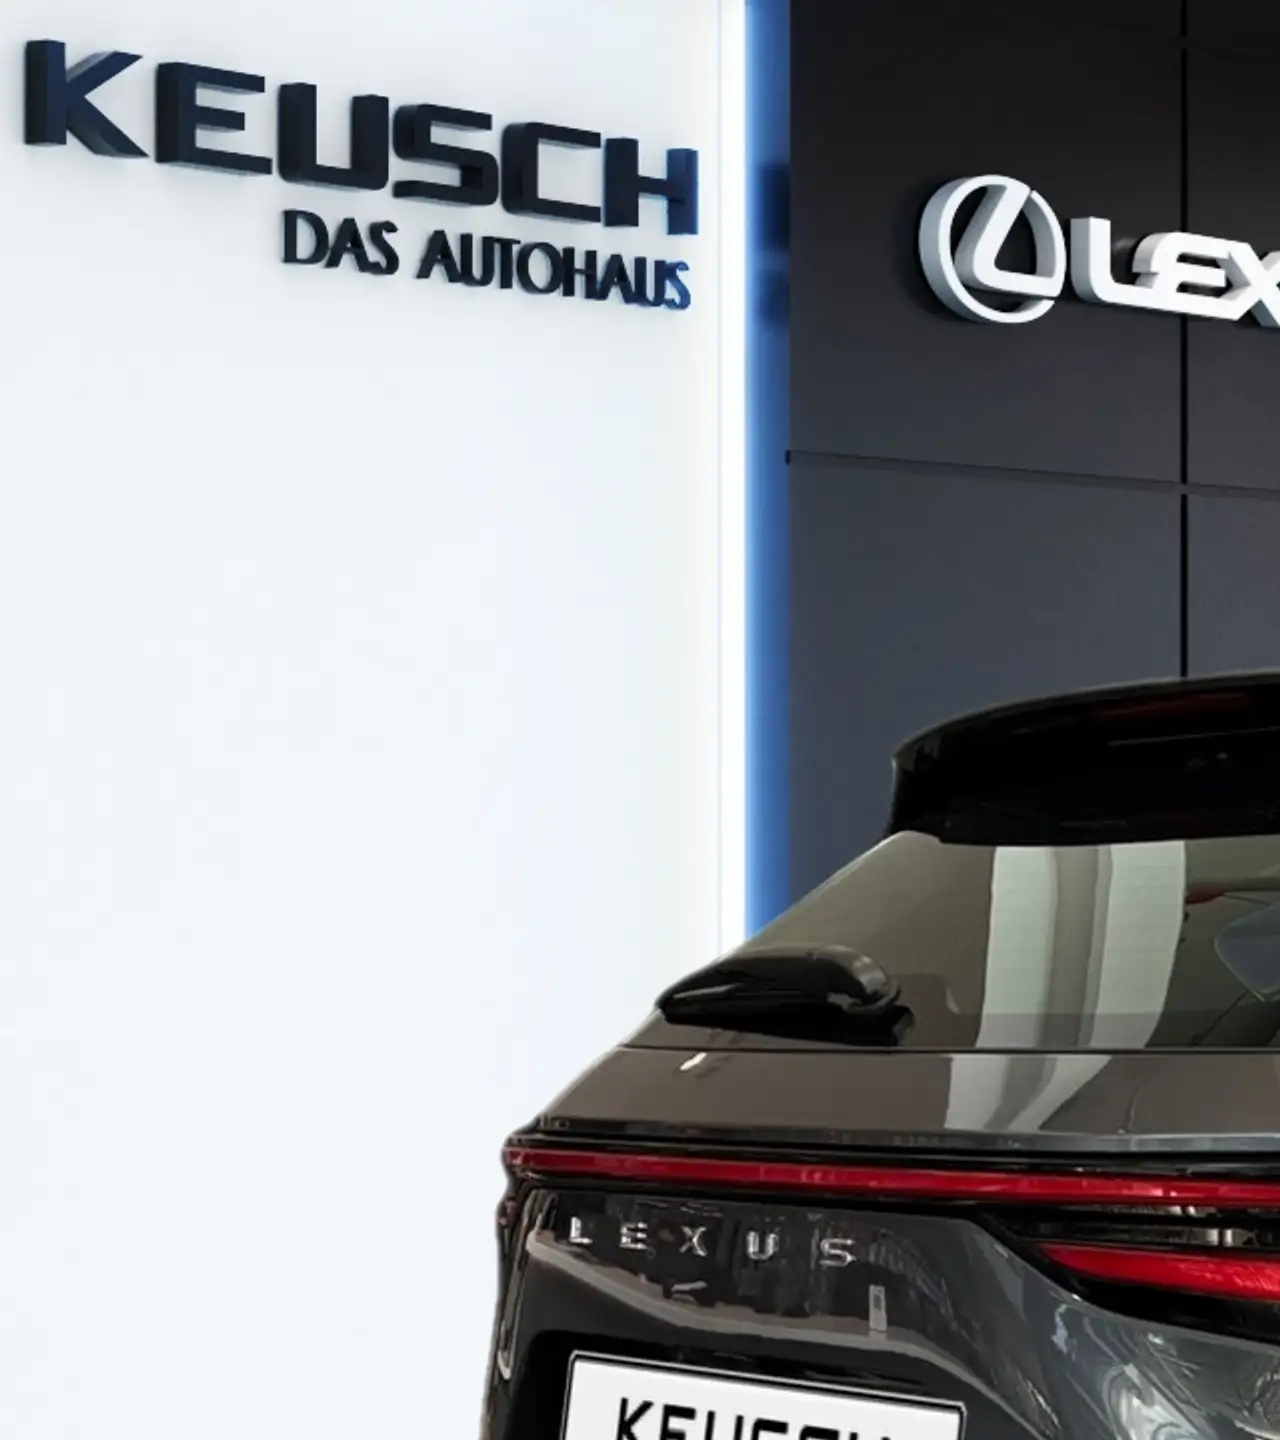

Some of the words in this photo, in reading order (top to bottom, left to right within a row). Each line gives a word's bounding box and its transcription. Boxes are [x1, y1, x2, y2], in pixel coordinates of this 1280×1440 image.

[24, 39, 699, 236] KEUSCH
[281, 209, 399, 276] DAS
[417, 229, 692, 311] AUTOHAUS
[568, 1215, 857, 1269] LEXUS
